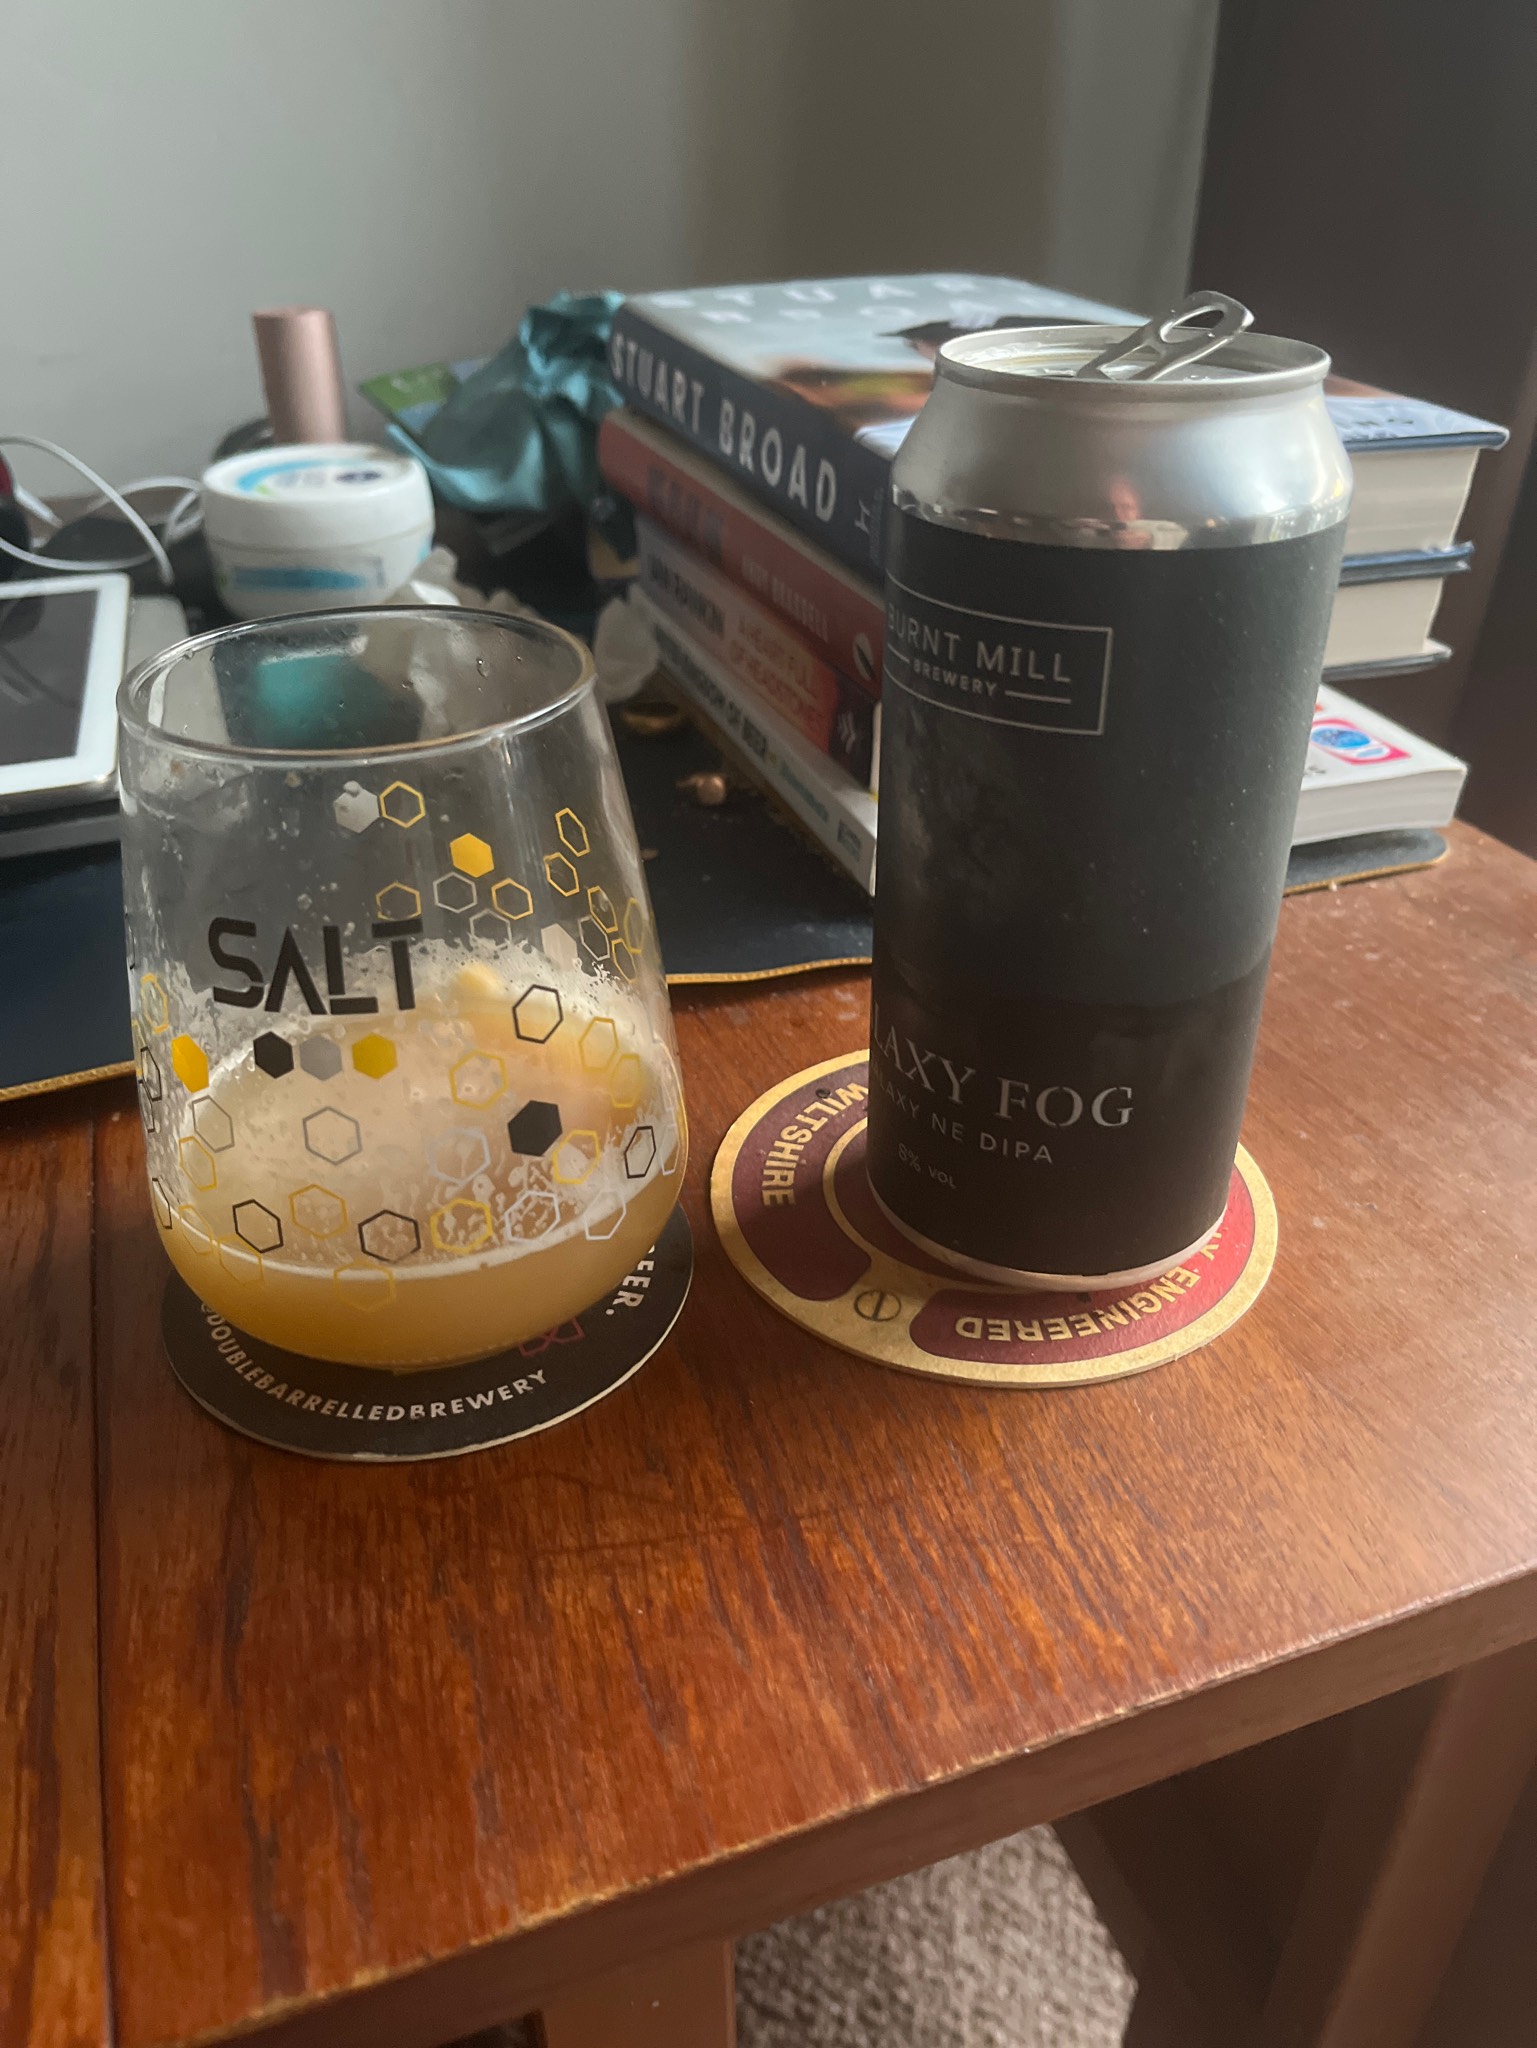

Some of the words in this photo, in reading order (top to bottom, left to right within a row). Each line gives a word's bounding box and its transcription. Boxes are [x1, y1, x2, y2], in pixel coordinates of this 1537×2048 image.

[611, 333, 705, 434] STUART
[718, 399, 837, 523] BROAD
[888, 602, 961, 662] BURNT
[976, 640, 1072, 684] MILL
[913, 658, 998, 697] BREWERY
[208, 916, 424, 1015] SALT
[873, 1000, 976, 1105] LAXY
[995, 1076, 1135, 1128] FOG
[761, 1082, 869, 1207] WILTSHIRE
[880, 1071, 920, 1119] LAXY
[931, 1112, 965, 1143] NE
[979, 1131, 1054, 1165] DIPA
[928, 1164, 958, 1190] VOL
[604, 1243, 656, 1317] EER.
[955, 1266, 1202, 1343] ENGINEERED
